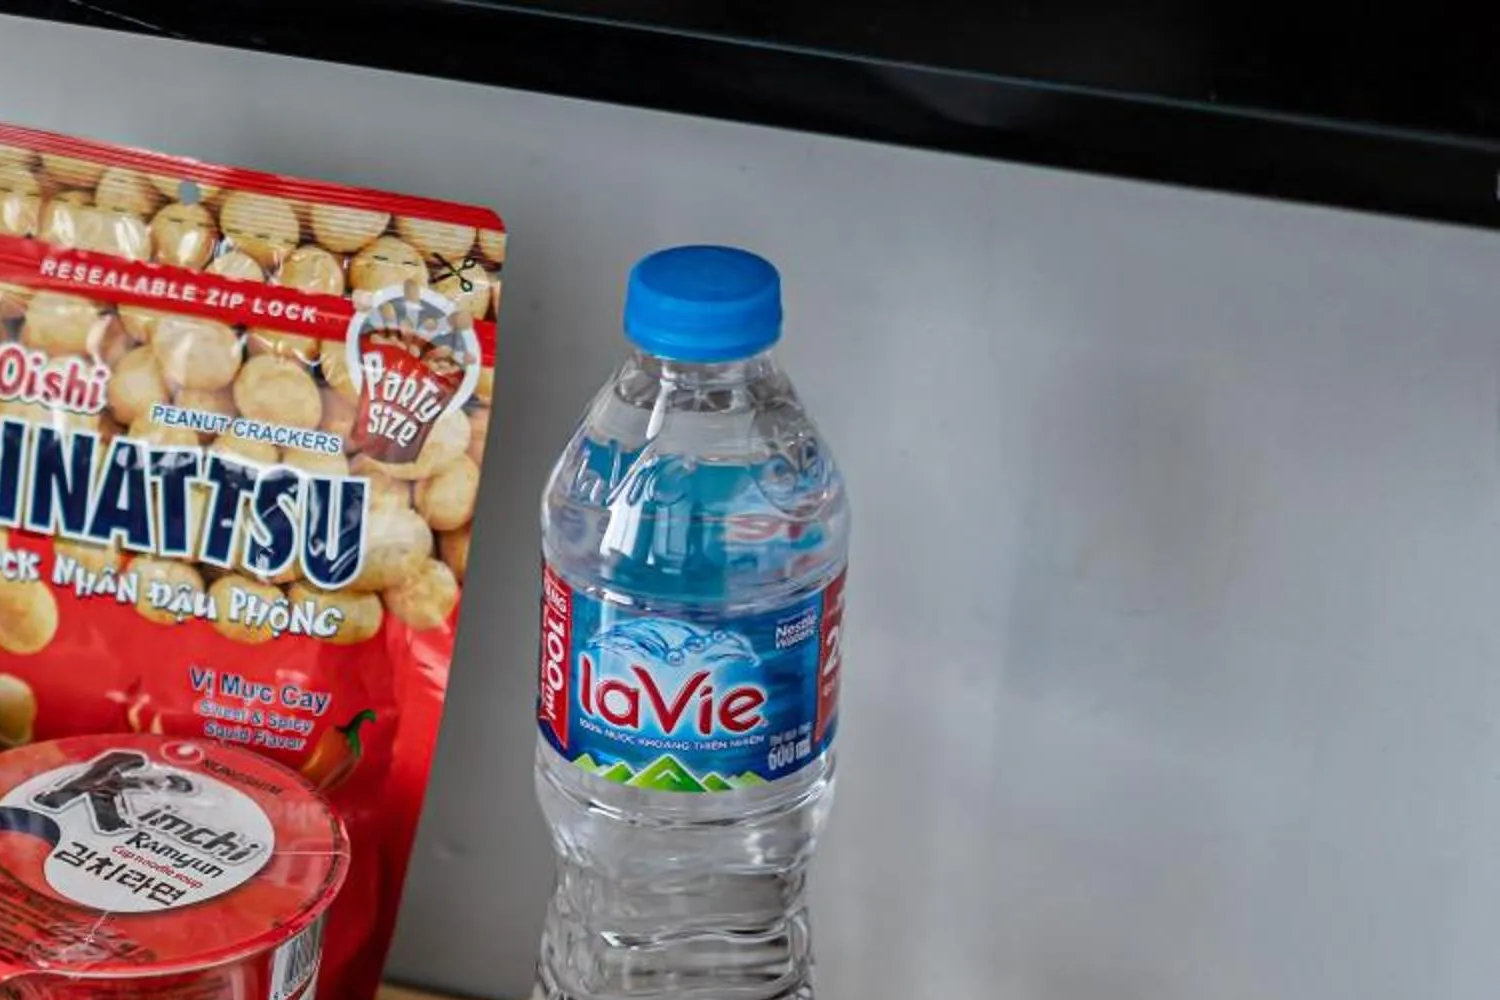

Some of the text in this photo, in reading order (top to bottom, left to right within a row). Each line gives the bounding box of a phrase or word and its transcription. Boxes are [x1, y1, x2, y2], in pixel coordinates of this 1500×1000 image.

[39, 259, 318, 324] RESEALABLE ZIP LOCK
[152, 403, 344, 454] PEANUT CRACKERS
[52, 553, 139, 605] NHÂN
[281, 684, 331, 716] Cay
[53, 840, 187, 907] 김치라면
